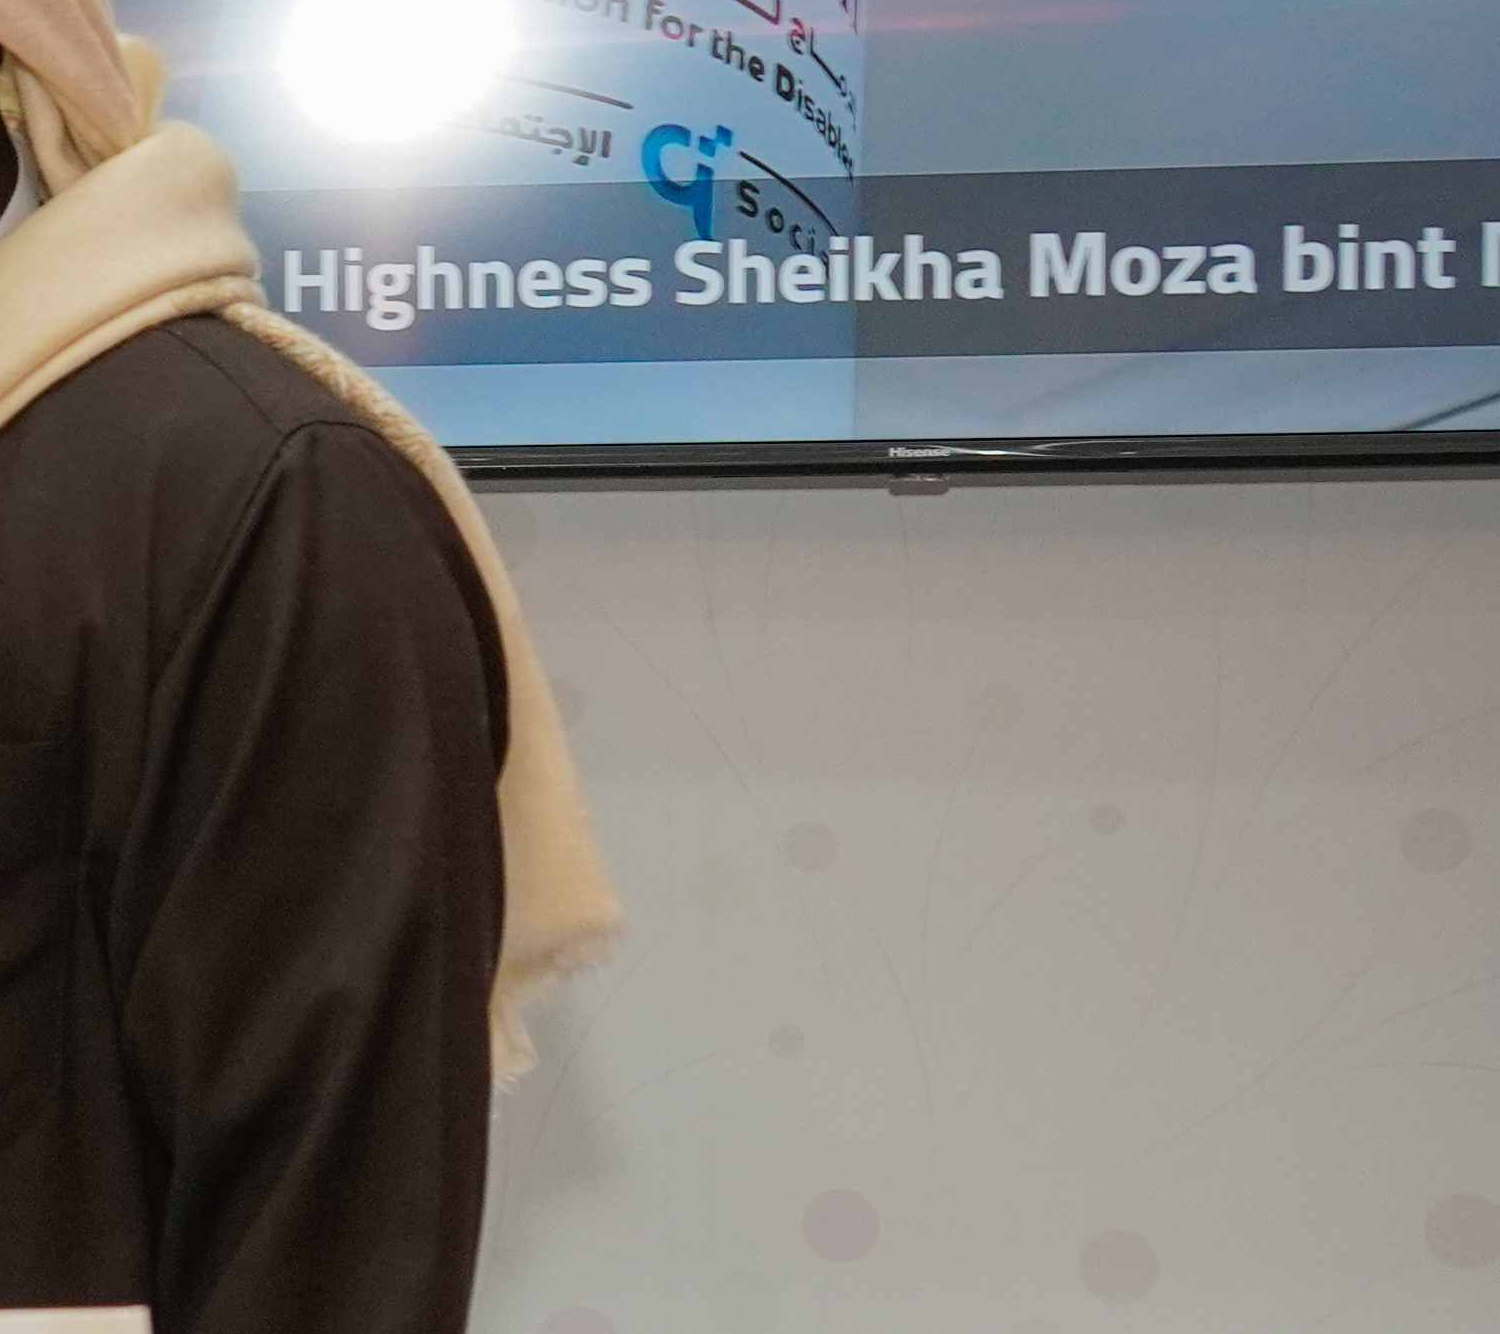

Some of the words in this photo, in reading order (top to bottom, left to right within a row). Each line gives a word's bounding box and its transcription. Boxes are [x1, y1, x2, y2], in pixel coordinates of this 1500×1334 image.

[711, 27, 765, 82] the
[282, 240, 652, 331] Highness
[674, 229, 1004, 307] Sheikha
[1028, 219, 1258, 296] Moza
[1282, 223, 1457, 293] bint
[889, 446, 951, 458] Hisense
